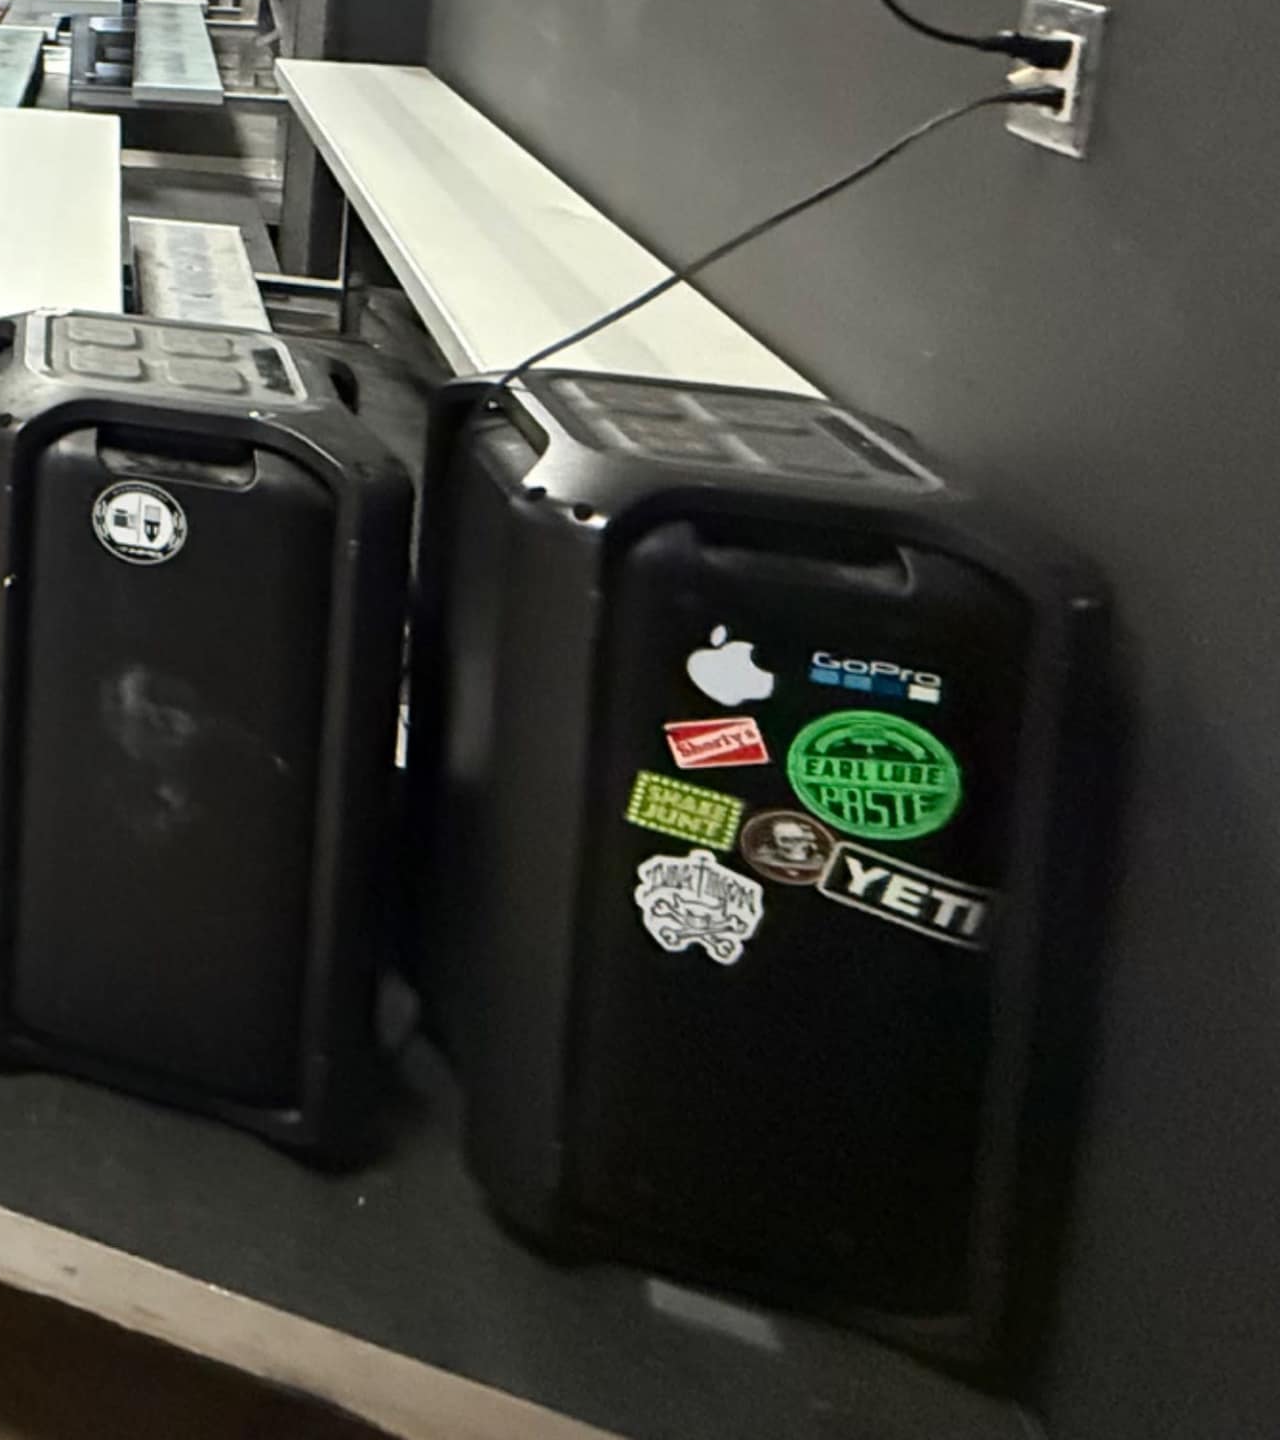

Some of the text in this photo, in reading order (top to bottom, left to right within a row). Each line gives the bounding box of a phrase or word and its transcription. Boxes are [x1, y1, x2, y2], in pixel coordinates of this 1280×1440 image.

[812, 650, 941, 688] GoPro
[805, 759, 868, 781] EARL
[640, 803, 721, 838] JUNT
[819, 785, 942, 828] PASTE
[844, 855, 985, 935] YETI
